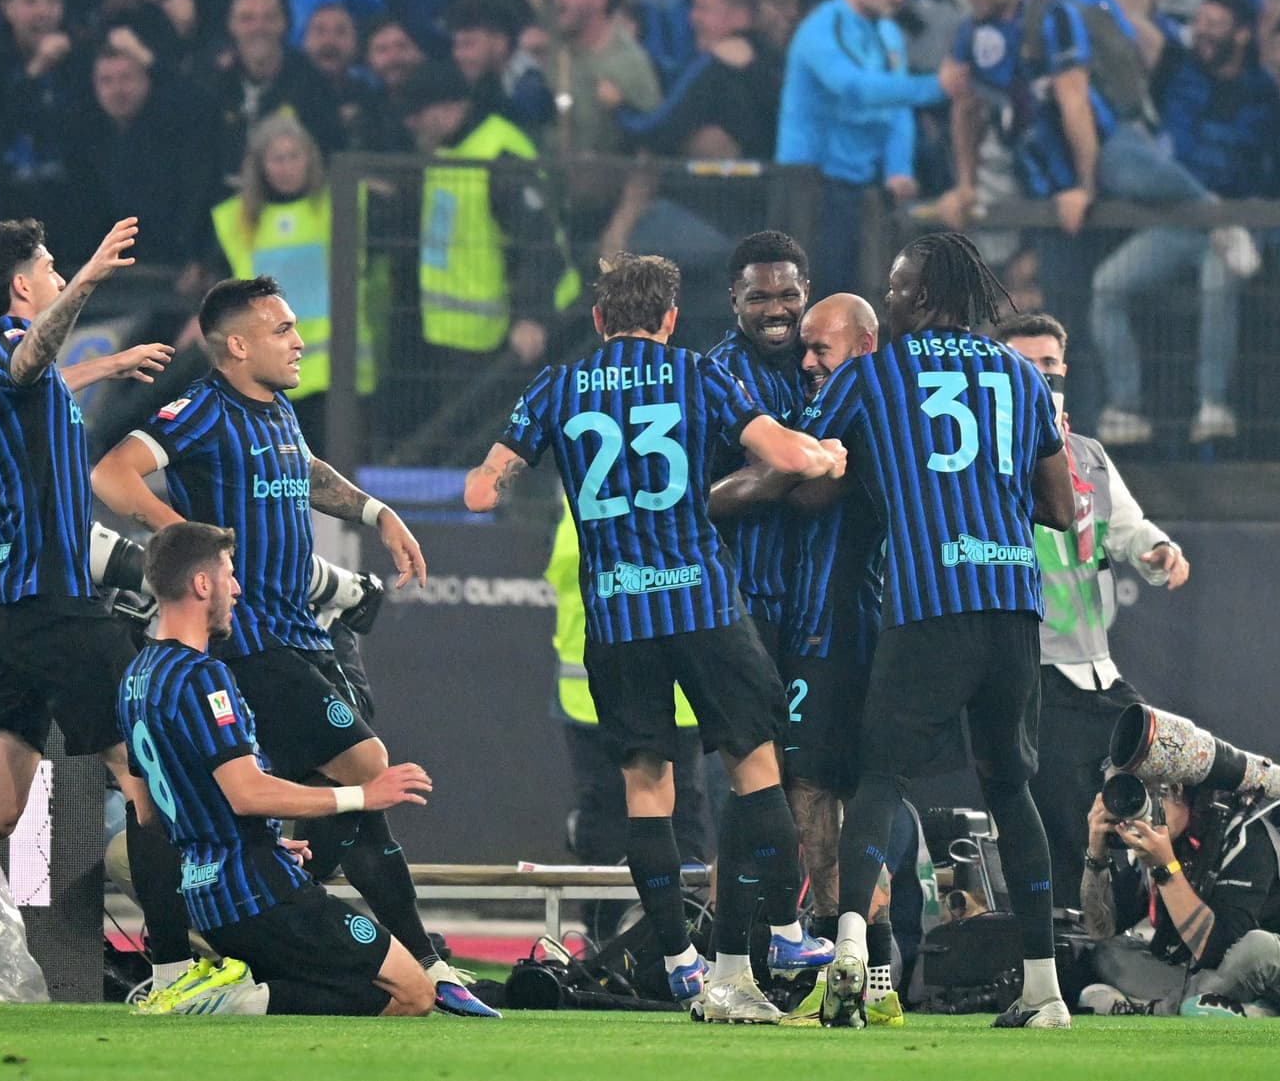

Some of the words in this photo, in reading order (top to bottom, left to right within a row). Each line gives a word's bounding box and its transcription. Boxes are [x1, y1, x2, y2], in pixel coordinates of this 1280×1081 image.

[576, 363, 674, 394] BARELLA
[917, 371, 1014, 476] 31
[252, 472, 310, 499] betsso
[563, 402, 689, 522] 23
[784, 678, 809, 722] 2
[132, 719, 177, 824] 8
